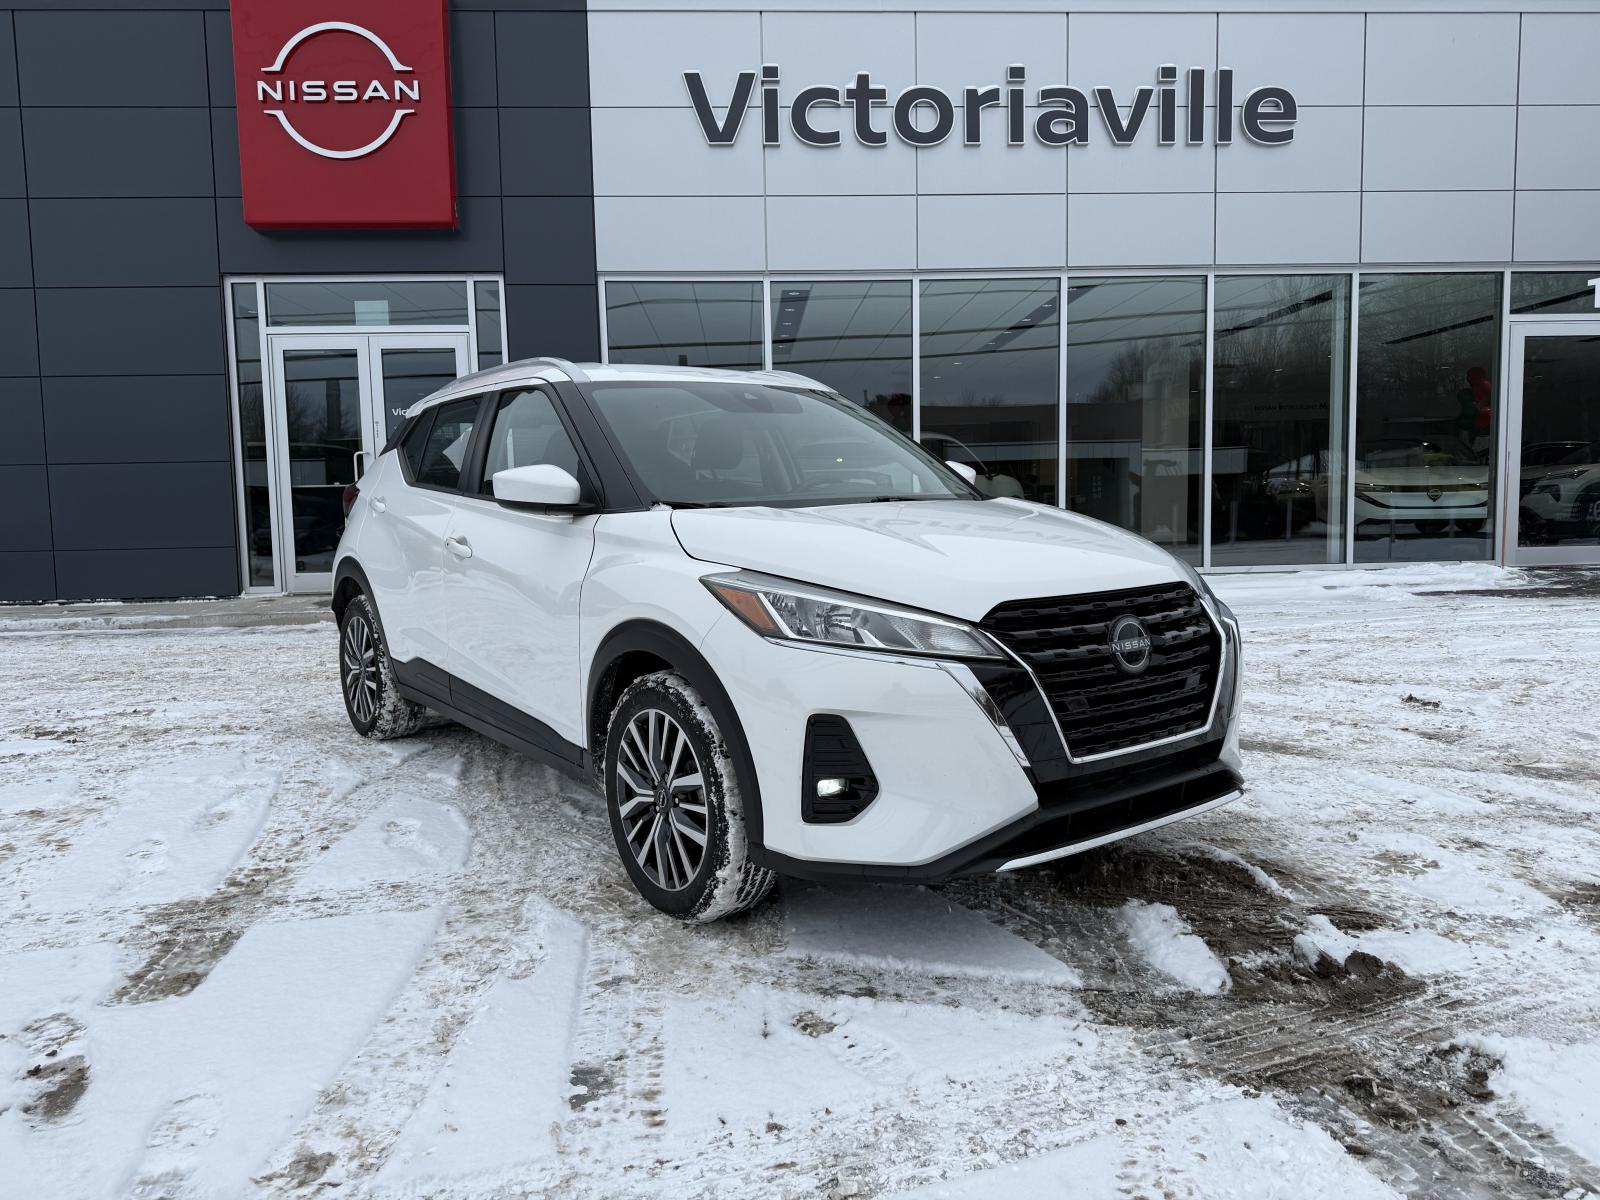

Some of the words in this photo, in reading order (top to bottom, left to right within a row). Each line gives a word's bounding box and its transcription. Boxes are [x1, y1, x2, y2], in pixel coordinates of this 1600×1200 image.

[256, 79, 420, 101] NISSAN
[682, 65, 1298, 147] Victoriaville
[1111, 638, 1151, 651] NISSAN
